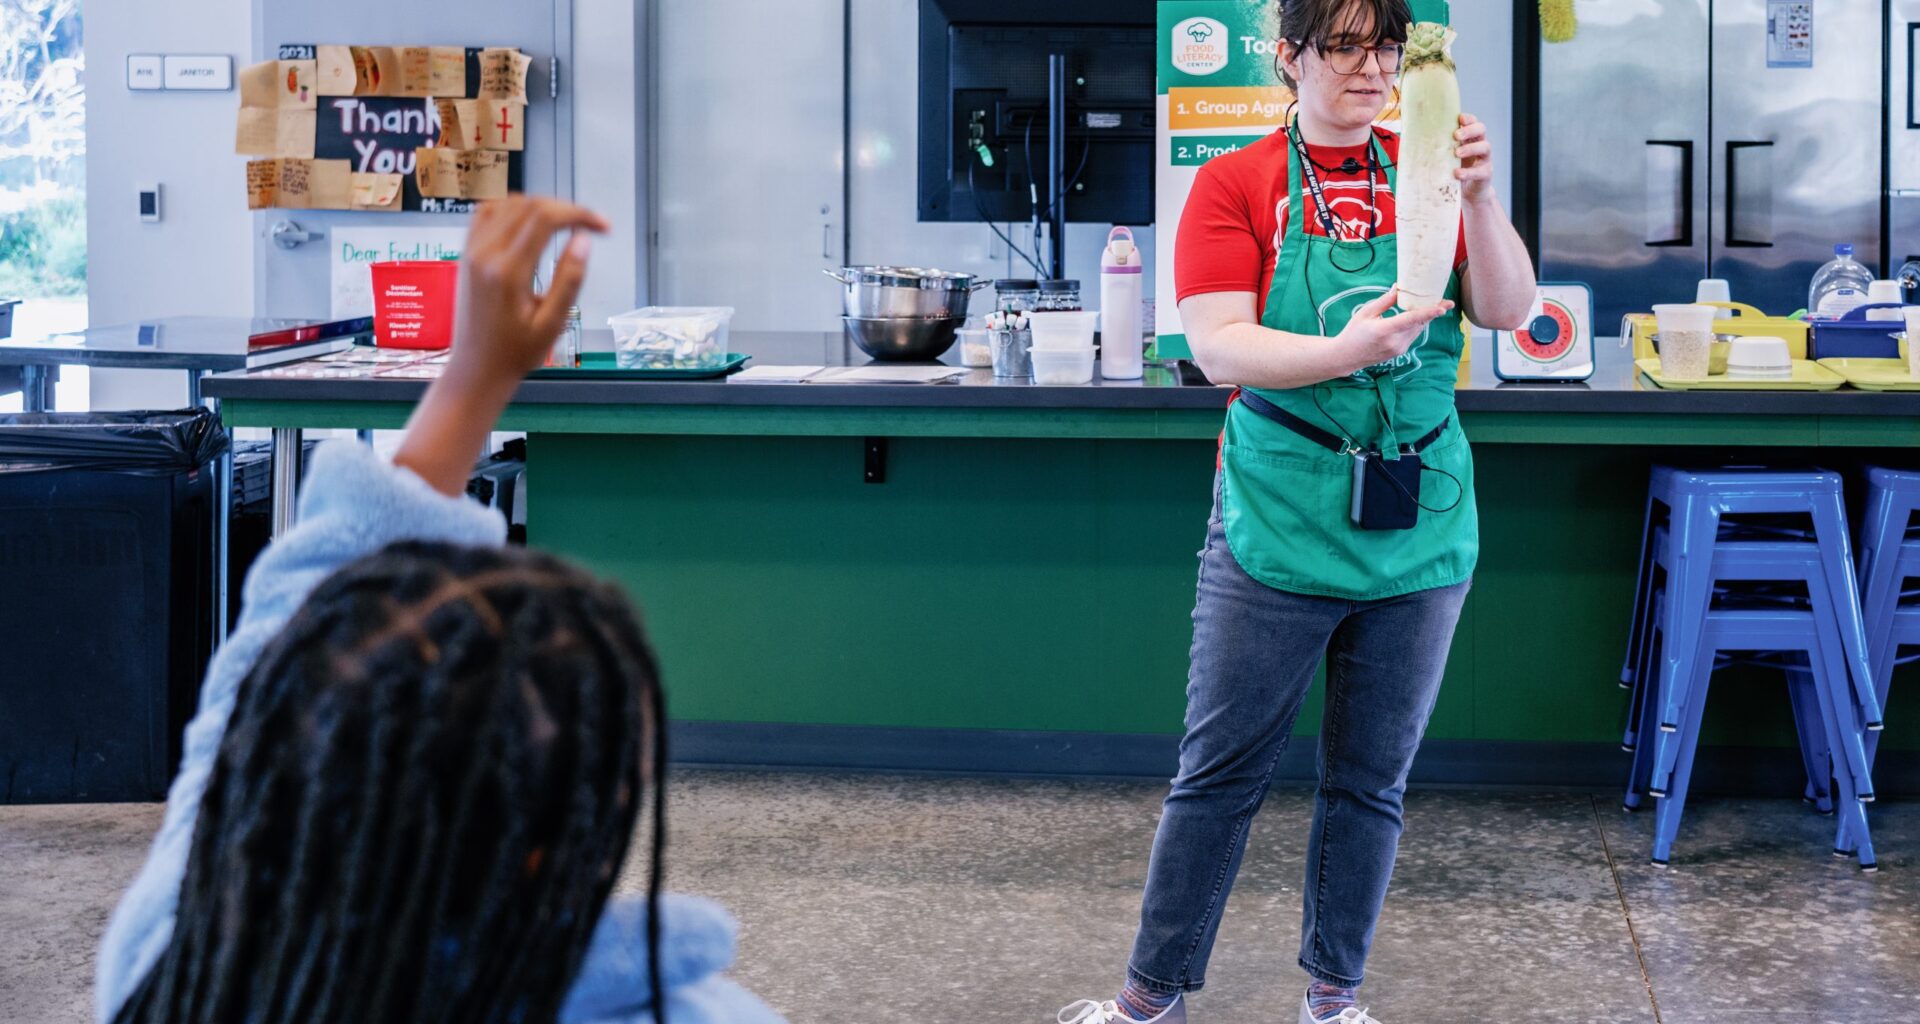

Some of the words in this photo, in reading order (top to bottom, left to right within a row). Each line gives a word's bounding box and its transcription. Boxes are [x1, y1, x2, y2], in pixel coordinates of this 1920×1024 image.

[1185, 45, 1215, 53] FOOD
[1177, 53, 1224, 63] LITERACY
[1177, 102, 1190, 115] 1.
[1195, 100, 1248, 117] Group
[1177, 146, 1192, 159] 2.
[1197, 144, 1240, 158] Prod
[342, 242, 380, 263] Dear
[389, 242, 420, 261] Food
